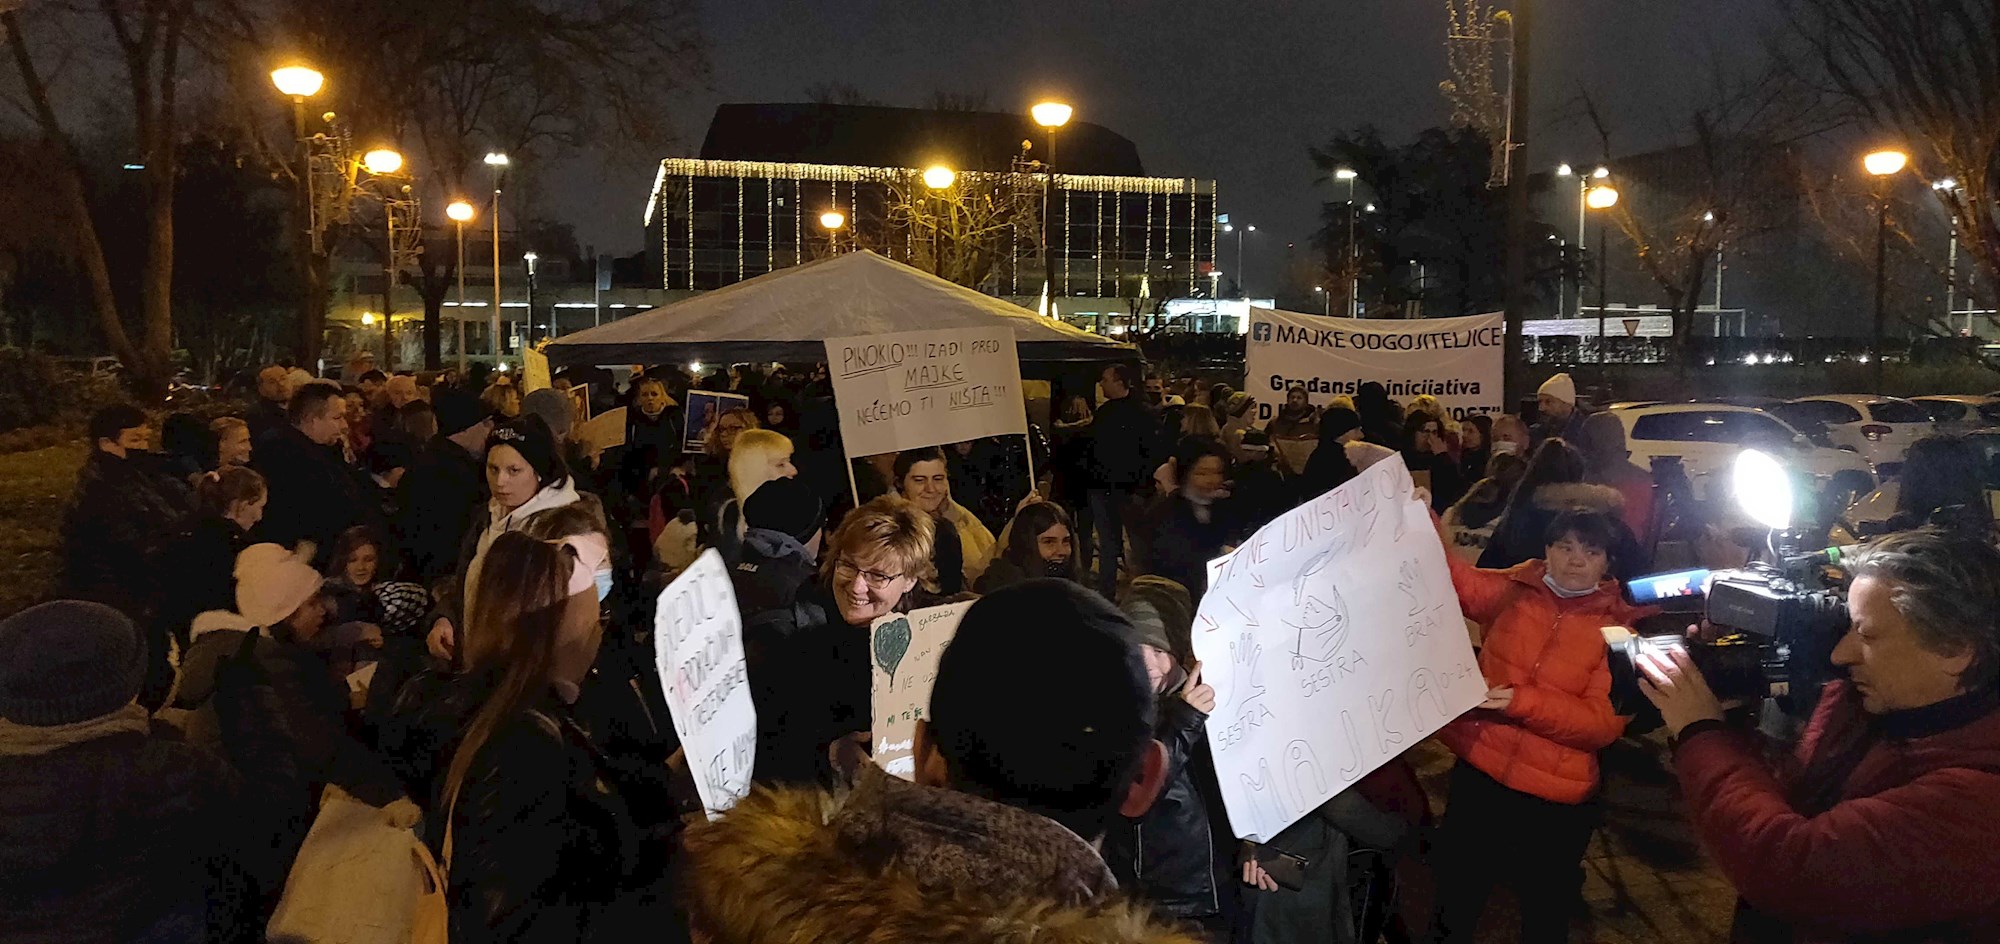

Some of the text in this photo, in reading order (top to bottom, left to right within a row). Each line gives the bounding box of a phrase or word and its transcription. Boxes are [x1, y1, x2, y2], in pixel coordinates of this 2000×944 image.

[971, 339, 1000, 356] PRED
[1276, 324, 1346, 349] MAJKE
[1350, 327, 1501, 350] ODGOJITELJICE
[904, 363, 965, 387] MAJKE
[1387, 379, 1480, 396] inicijativa
[921, 396, 934, 409] TI
[1245, 523, 1272, 570] NE
[1405, 604, 1444, 648] BRAT
[1302, 649, 1368, 698] SESTRA
[1218, 703, 1275, 751] SESTRA
[1240, 667, 1448, 838] MAJKA
